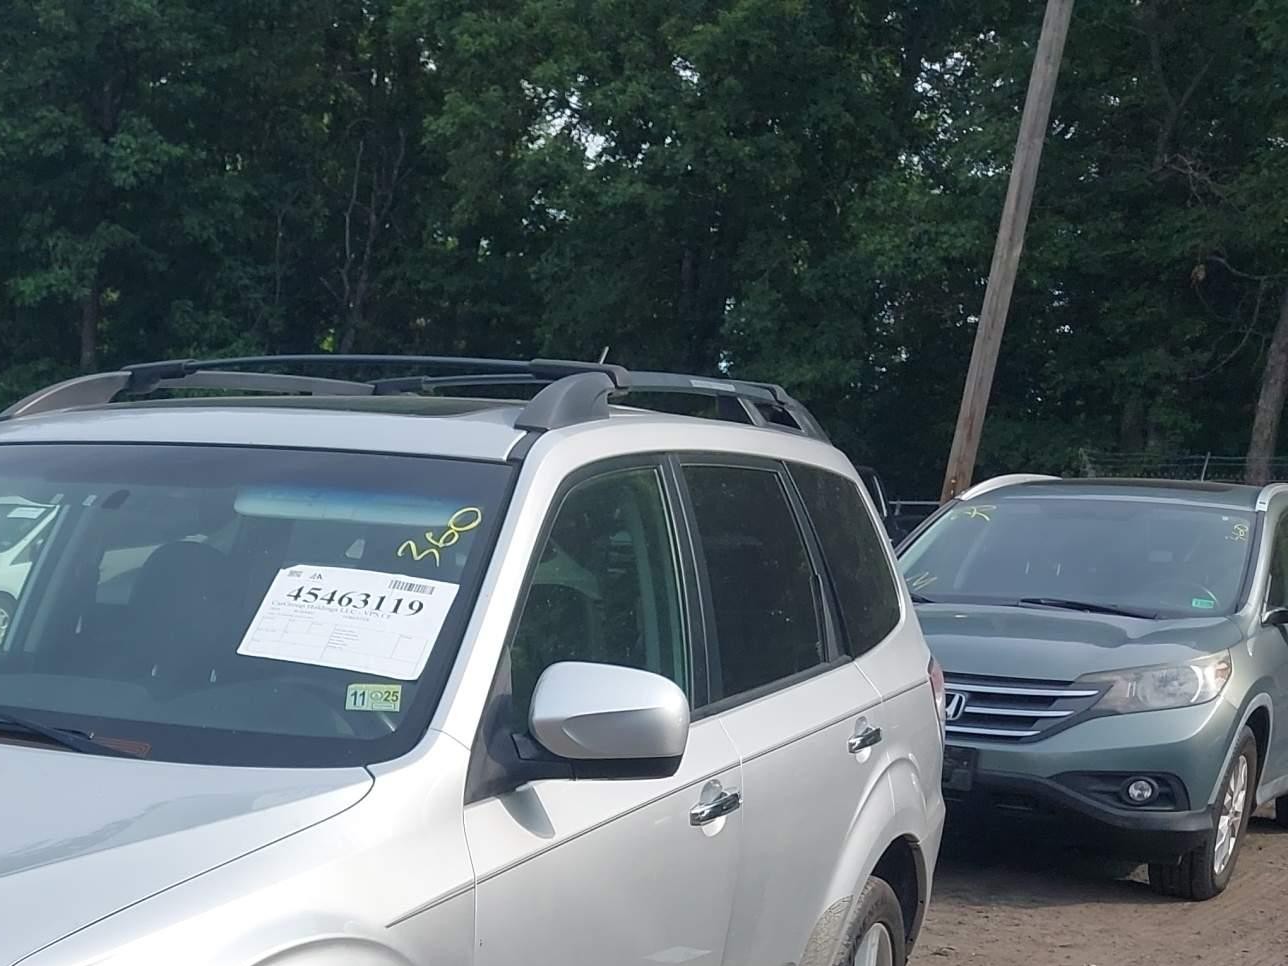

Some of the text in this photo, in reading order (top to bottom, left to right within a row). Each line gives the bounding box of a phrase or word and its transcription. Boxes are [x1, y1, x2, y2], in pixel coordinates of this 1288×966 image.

[397, 507, 482, 567] 360
[286, 585, 424, 616] 45463119
[350, 690, 399, 706] 11 25
